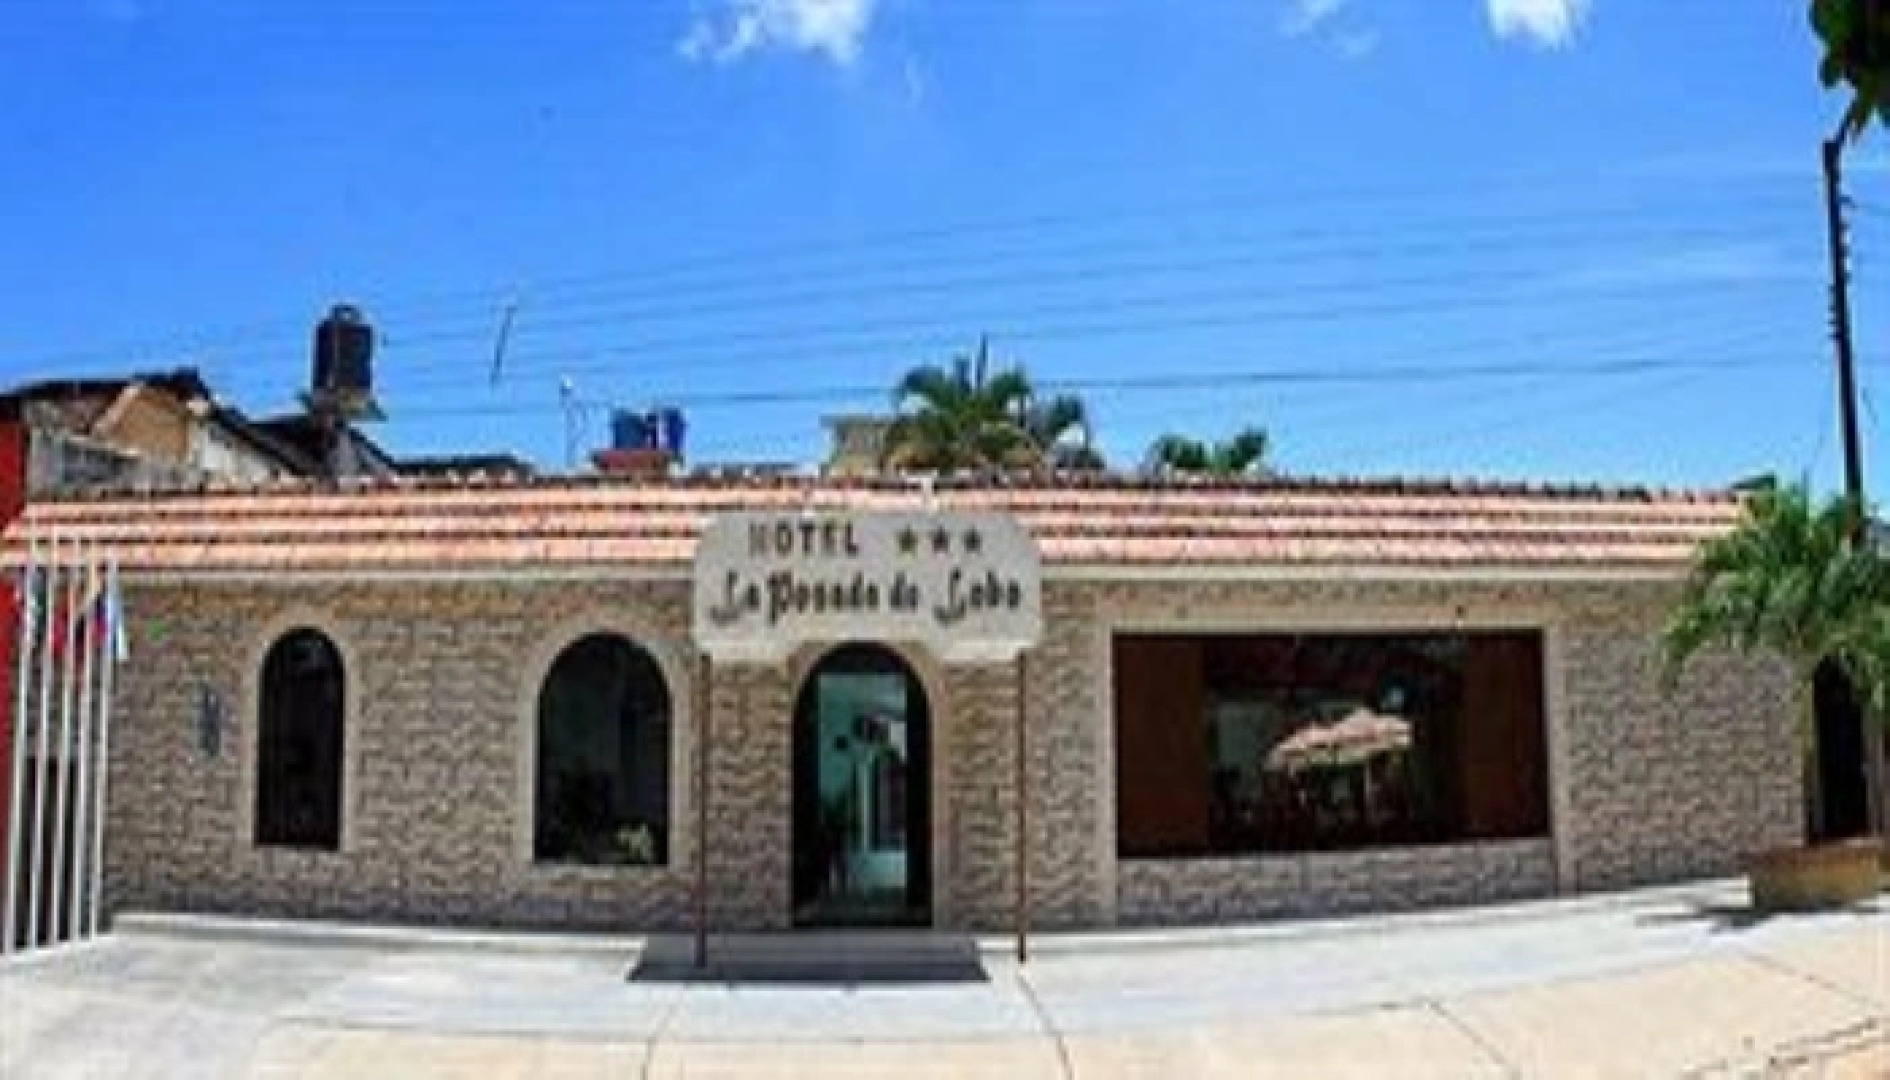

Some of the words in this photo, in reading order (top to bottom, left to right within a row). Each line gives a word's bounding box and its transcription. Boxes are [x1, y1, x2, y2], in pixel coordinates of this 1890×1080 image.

[748, 519, 859, 557] HOTEL
[709, 568, 762, 627] La
[766, 569, 881, 627] Posada
[932, 566, 1022, 629] Lobo
